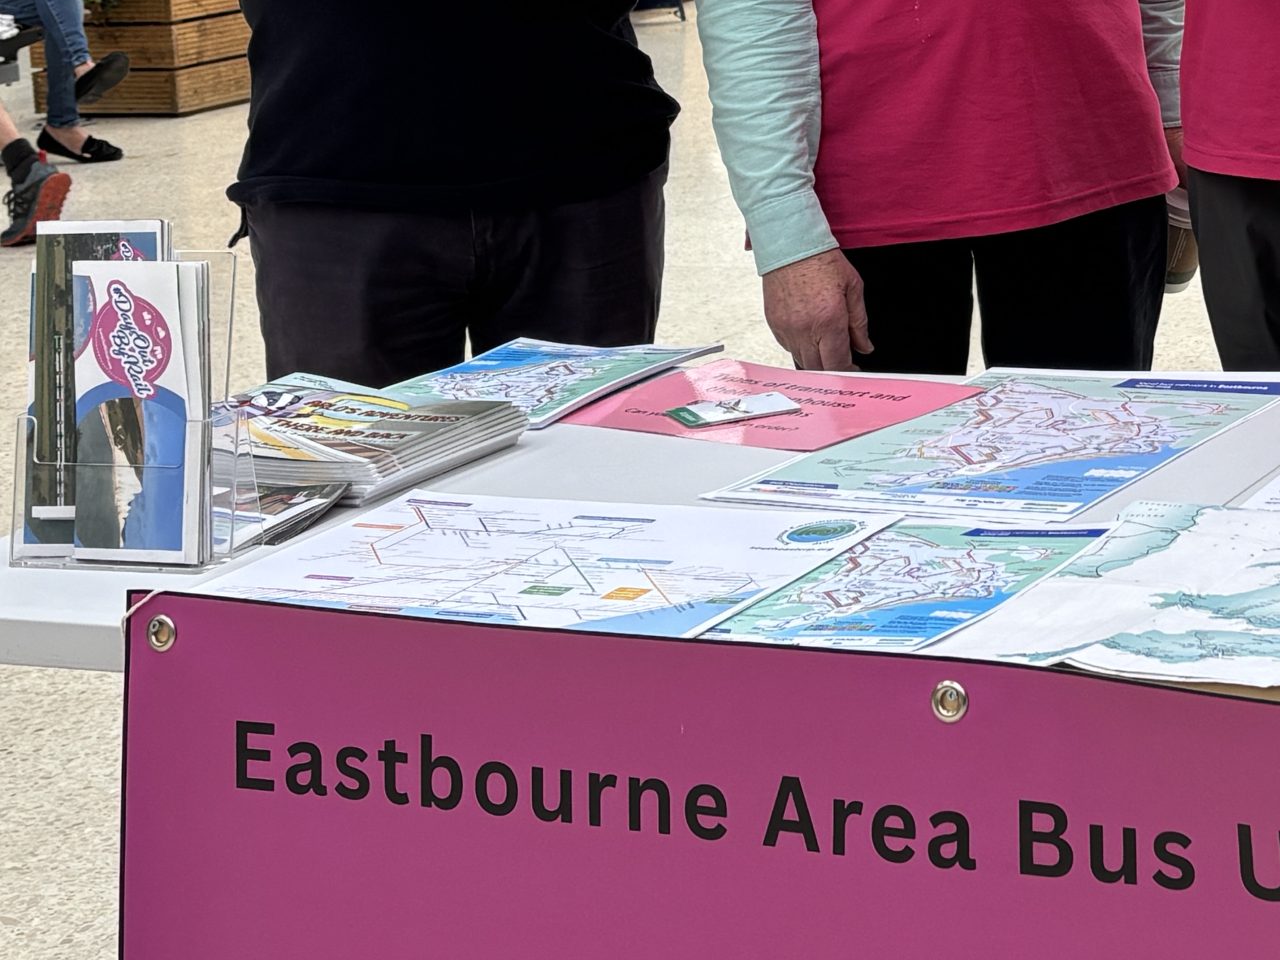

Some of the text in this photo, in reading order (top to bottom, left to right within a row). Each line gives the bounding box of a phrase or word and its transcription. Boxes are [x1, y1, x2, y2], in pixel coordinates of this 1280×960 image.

[112, 331, 151, 395] By Rail
[133, 333, 154, 367] Out
[714, 374, 912, 403] Types of transport and
[270, 418, 329, 435] THERE
[330, 427, 366, 438] AND
[367, 430, 408, 440] BACK
[235, 720, 729, 841] Eastbourne
[763, 777, 976, 872] Area
[1018, 800, 1196, 890] Bus
